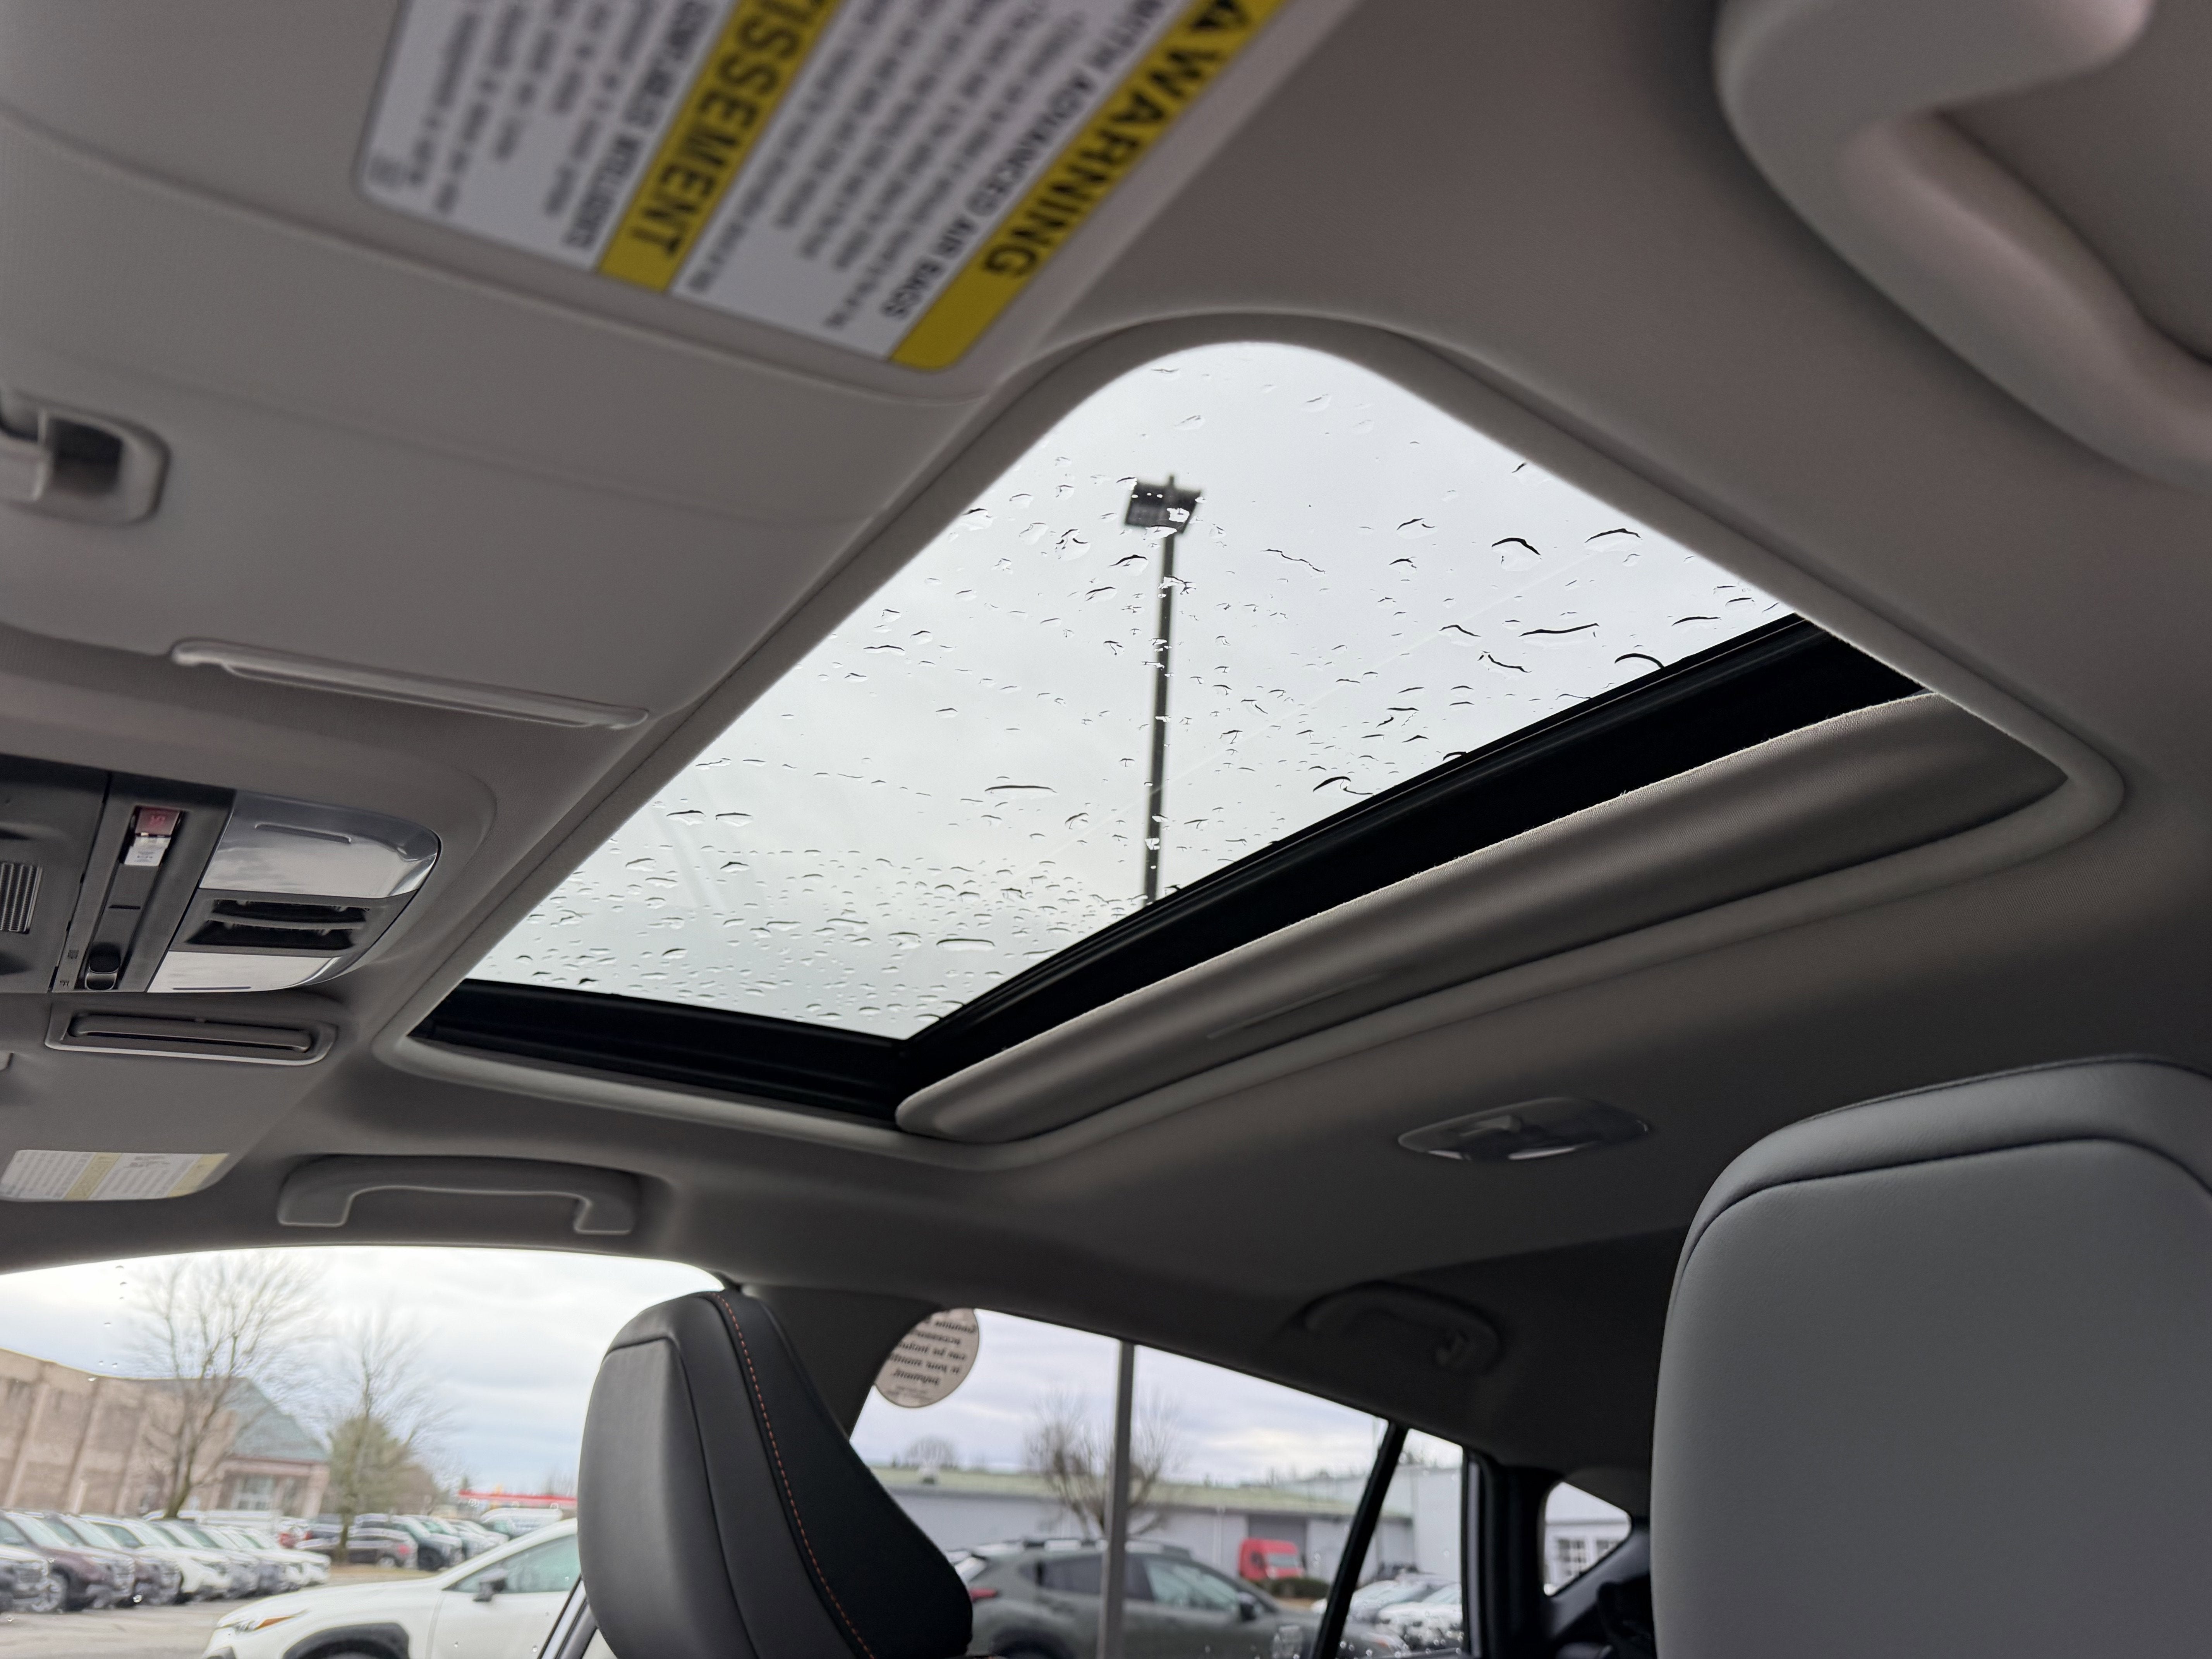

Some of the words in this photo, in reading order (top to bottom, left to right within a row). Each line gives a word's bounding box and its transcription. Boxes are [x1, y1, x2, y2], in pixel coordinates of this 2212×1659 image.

[628, 0, 829, 258] ISSEMENT
[965, 70, 1096, 216] ADVANCED
[984, 47, 1224, 276] WARNING
[881, 256, 945, 318] BAGS
